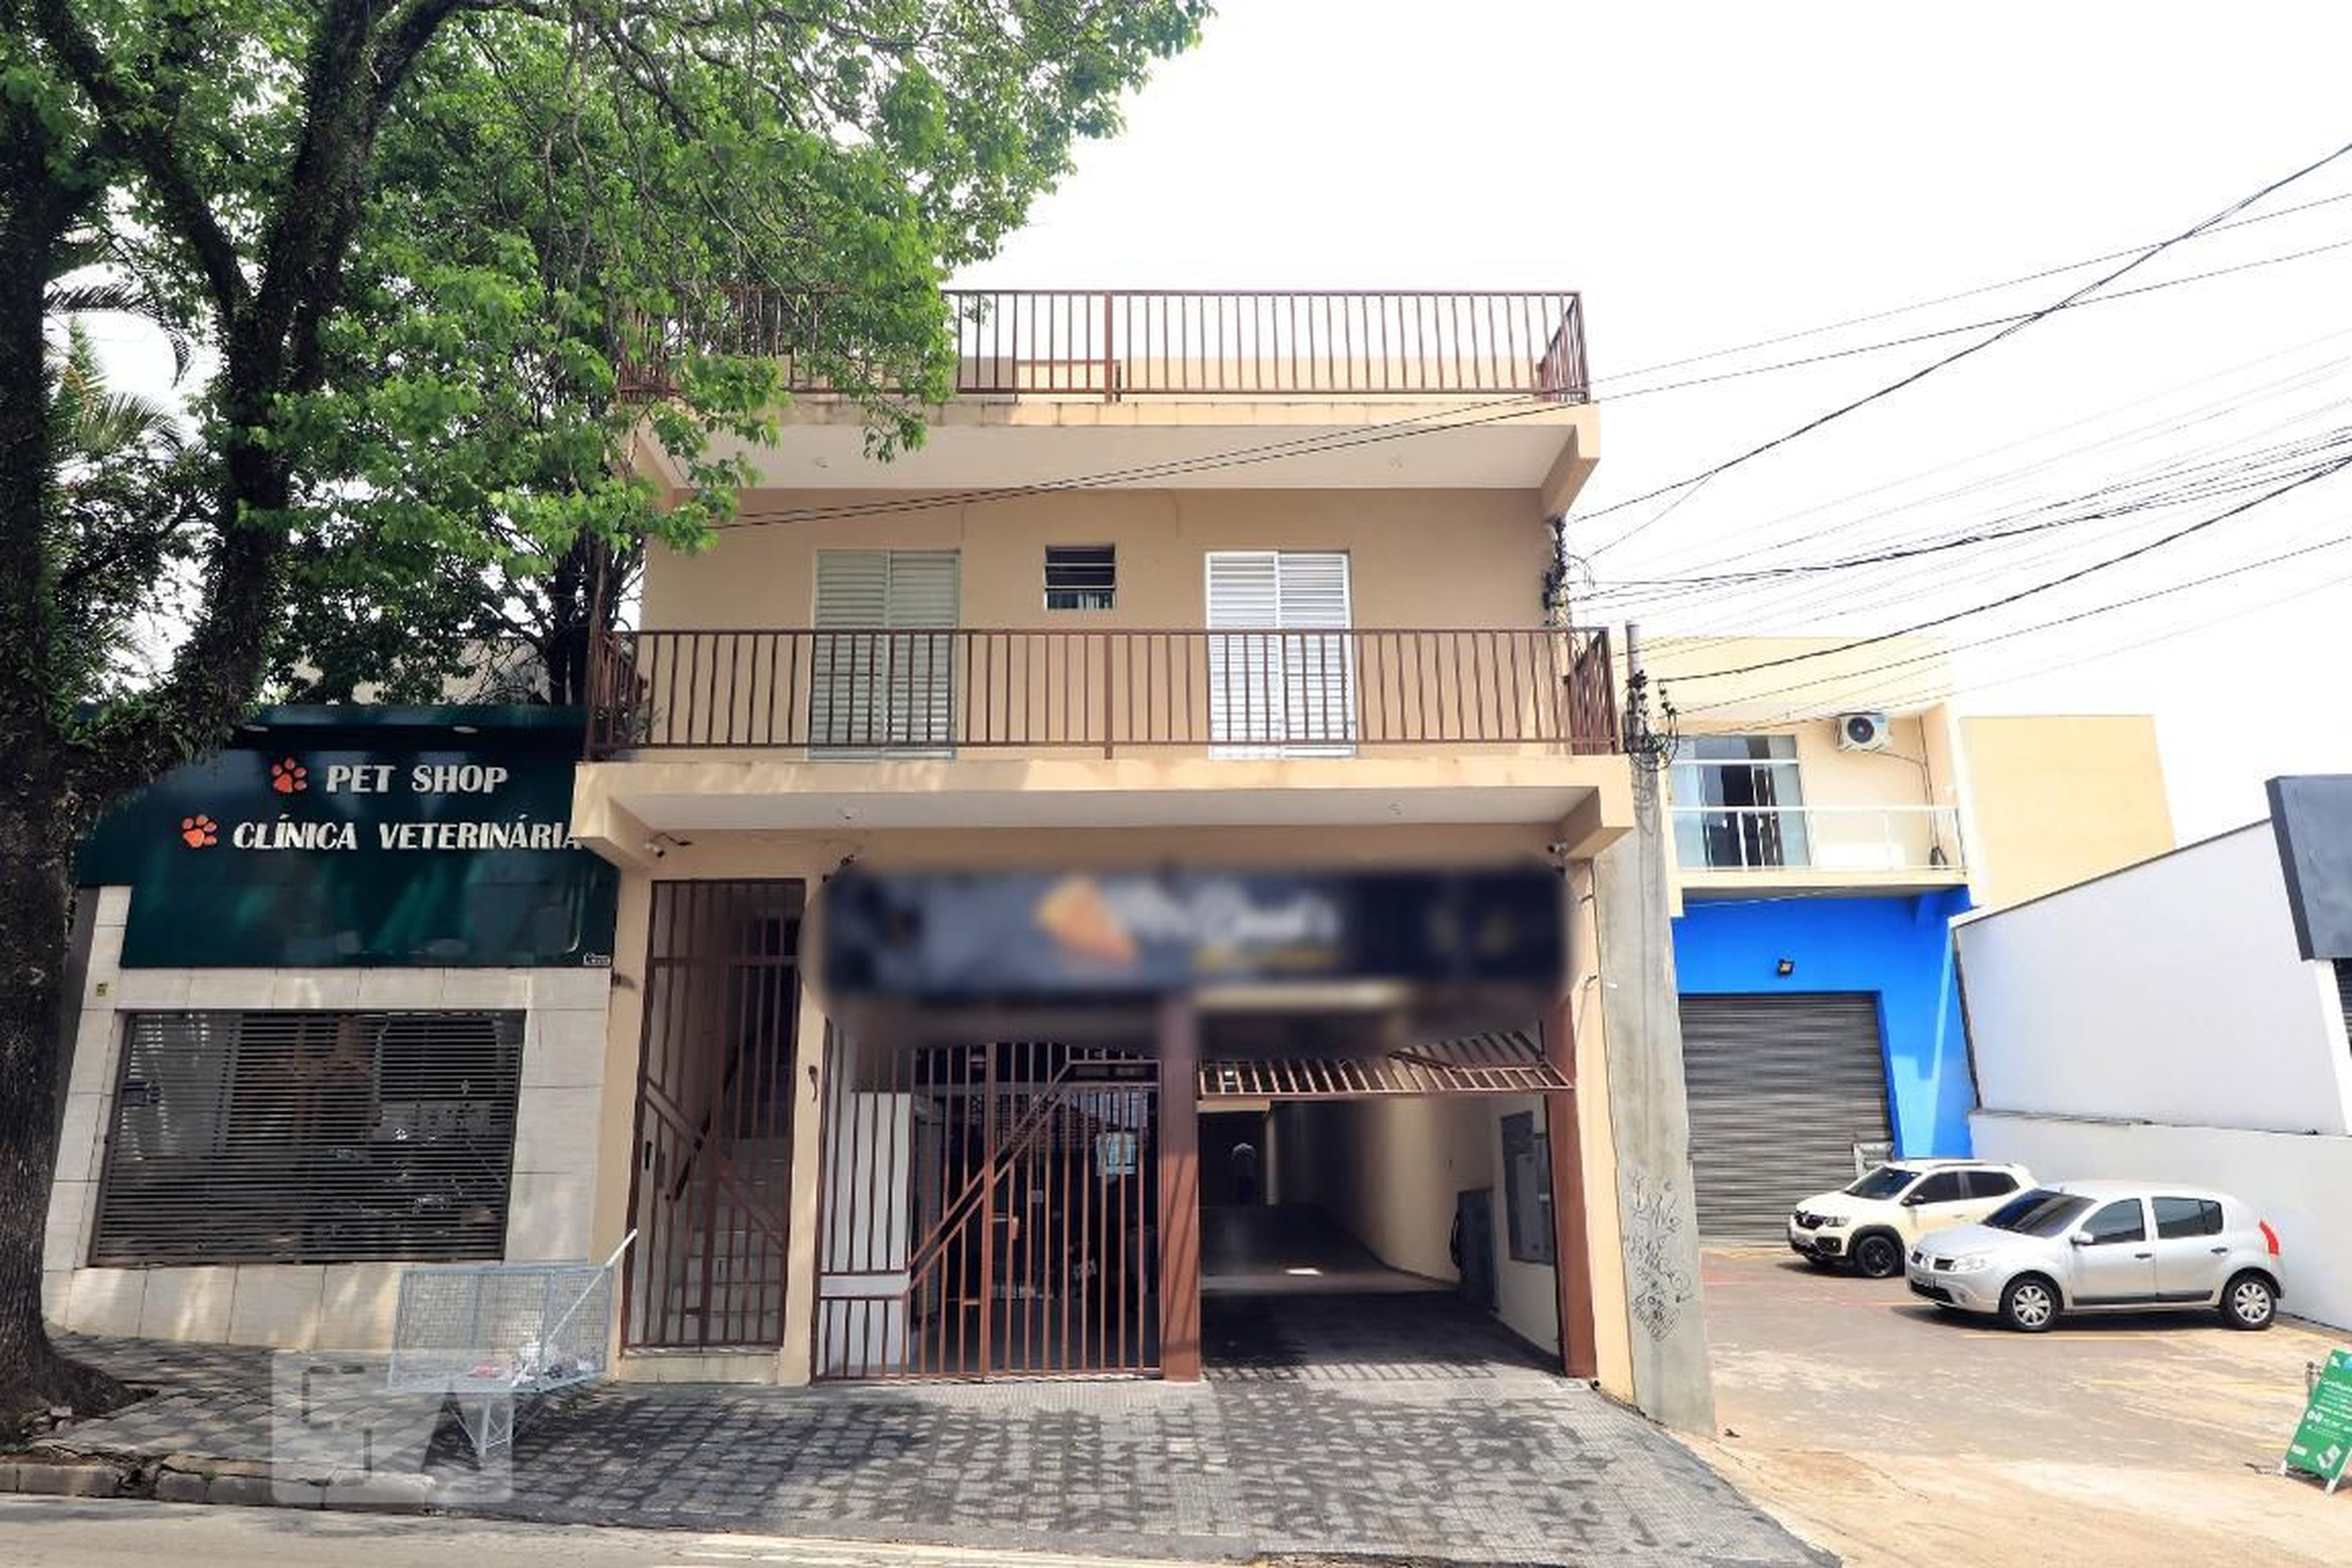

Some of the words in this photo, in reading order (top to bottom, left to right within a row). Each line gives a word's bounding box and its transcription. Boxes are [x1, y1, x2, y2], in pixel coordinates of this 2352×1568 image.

[325, 764, 397, 793] PET
[411, 764, 509, 794] SHOP
[232, 814, 358, 850] CLÍNICA
